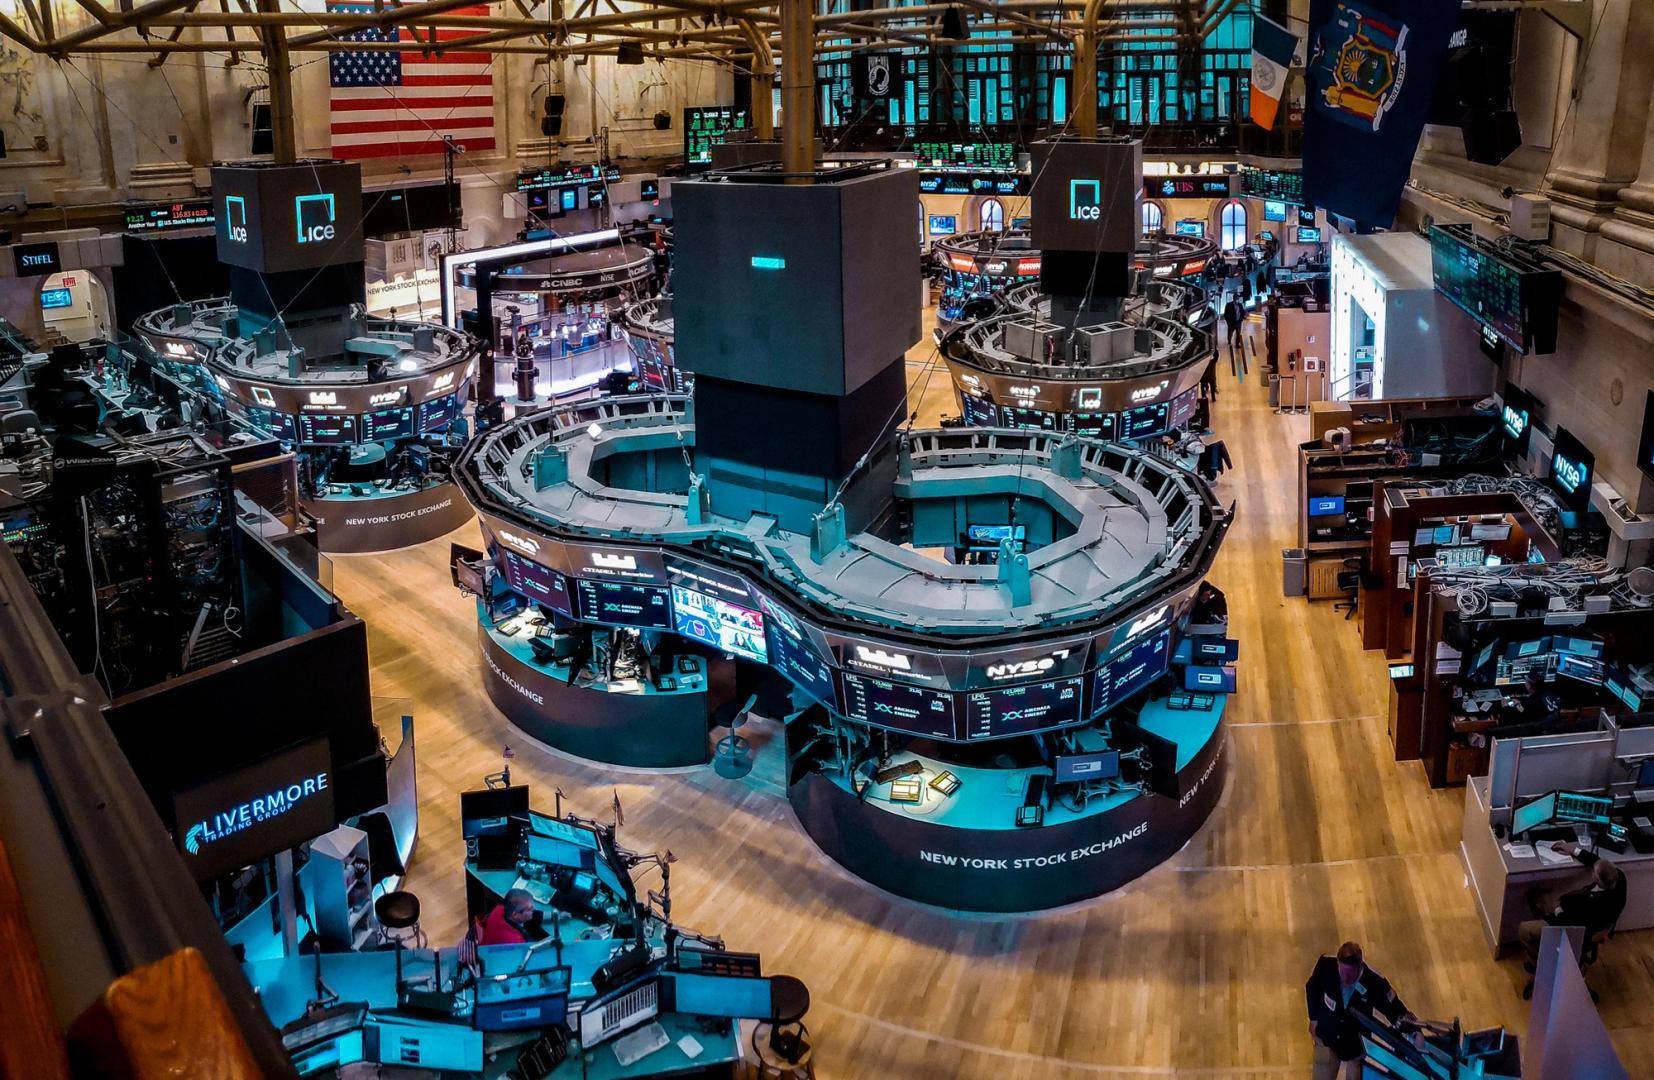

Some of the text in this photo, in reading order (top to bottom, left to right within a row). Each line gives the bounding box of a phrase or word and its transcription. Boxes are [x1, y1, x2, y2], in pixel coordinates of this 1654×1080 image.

[1175, 181, 1194, 193] UBS
[171, 204, 184, 212] ABT
[22, 254, 54, 266] STIFEL
[551, 278, 583, 288] CNBC
[600, 273, 615, 282] NYSE
[367, 286, 380, 295] NEW
[381, 284, 397, 293] YORK
[397, 281, 416, 290] STOCK
[345, 498, 452, 526] NEW YORK STOCK EXCHANGE
[582, 567, 616, 576] CITADEL
[501, 671, 544, 706] EXCHANGE
[972, 692, 985, 700] LFG
[894, 711, 917, 719] ENERGY
[1024, 710, 1047, 718] ENERGY
[1179, 757, 1217, 809] NEW YORK
[202, 772, 329, 838] LIVERMORE
[204, 803, 293, 844] TRADING GROUP
[920, 821, 1149, 870] NEW YORK STOCK EXCHANGE
